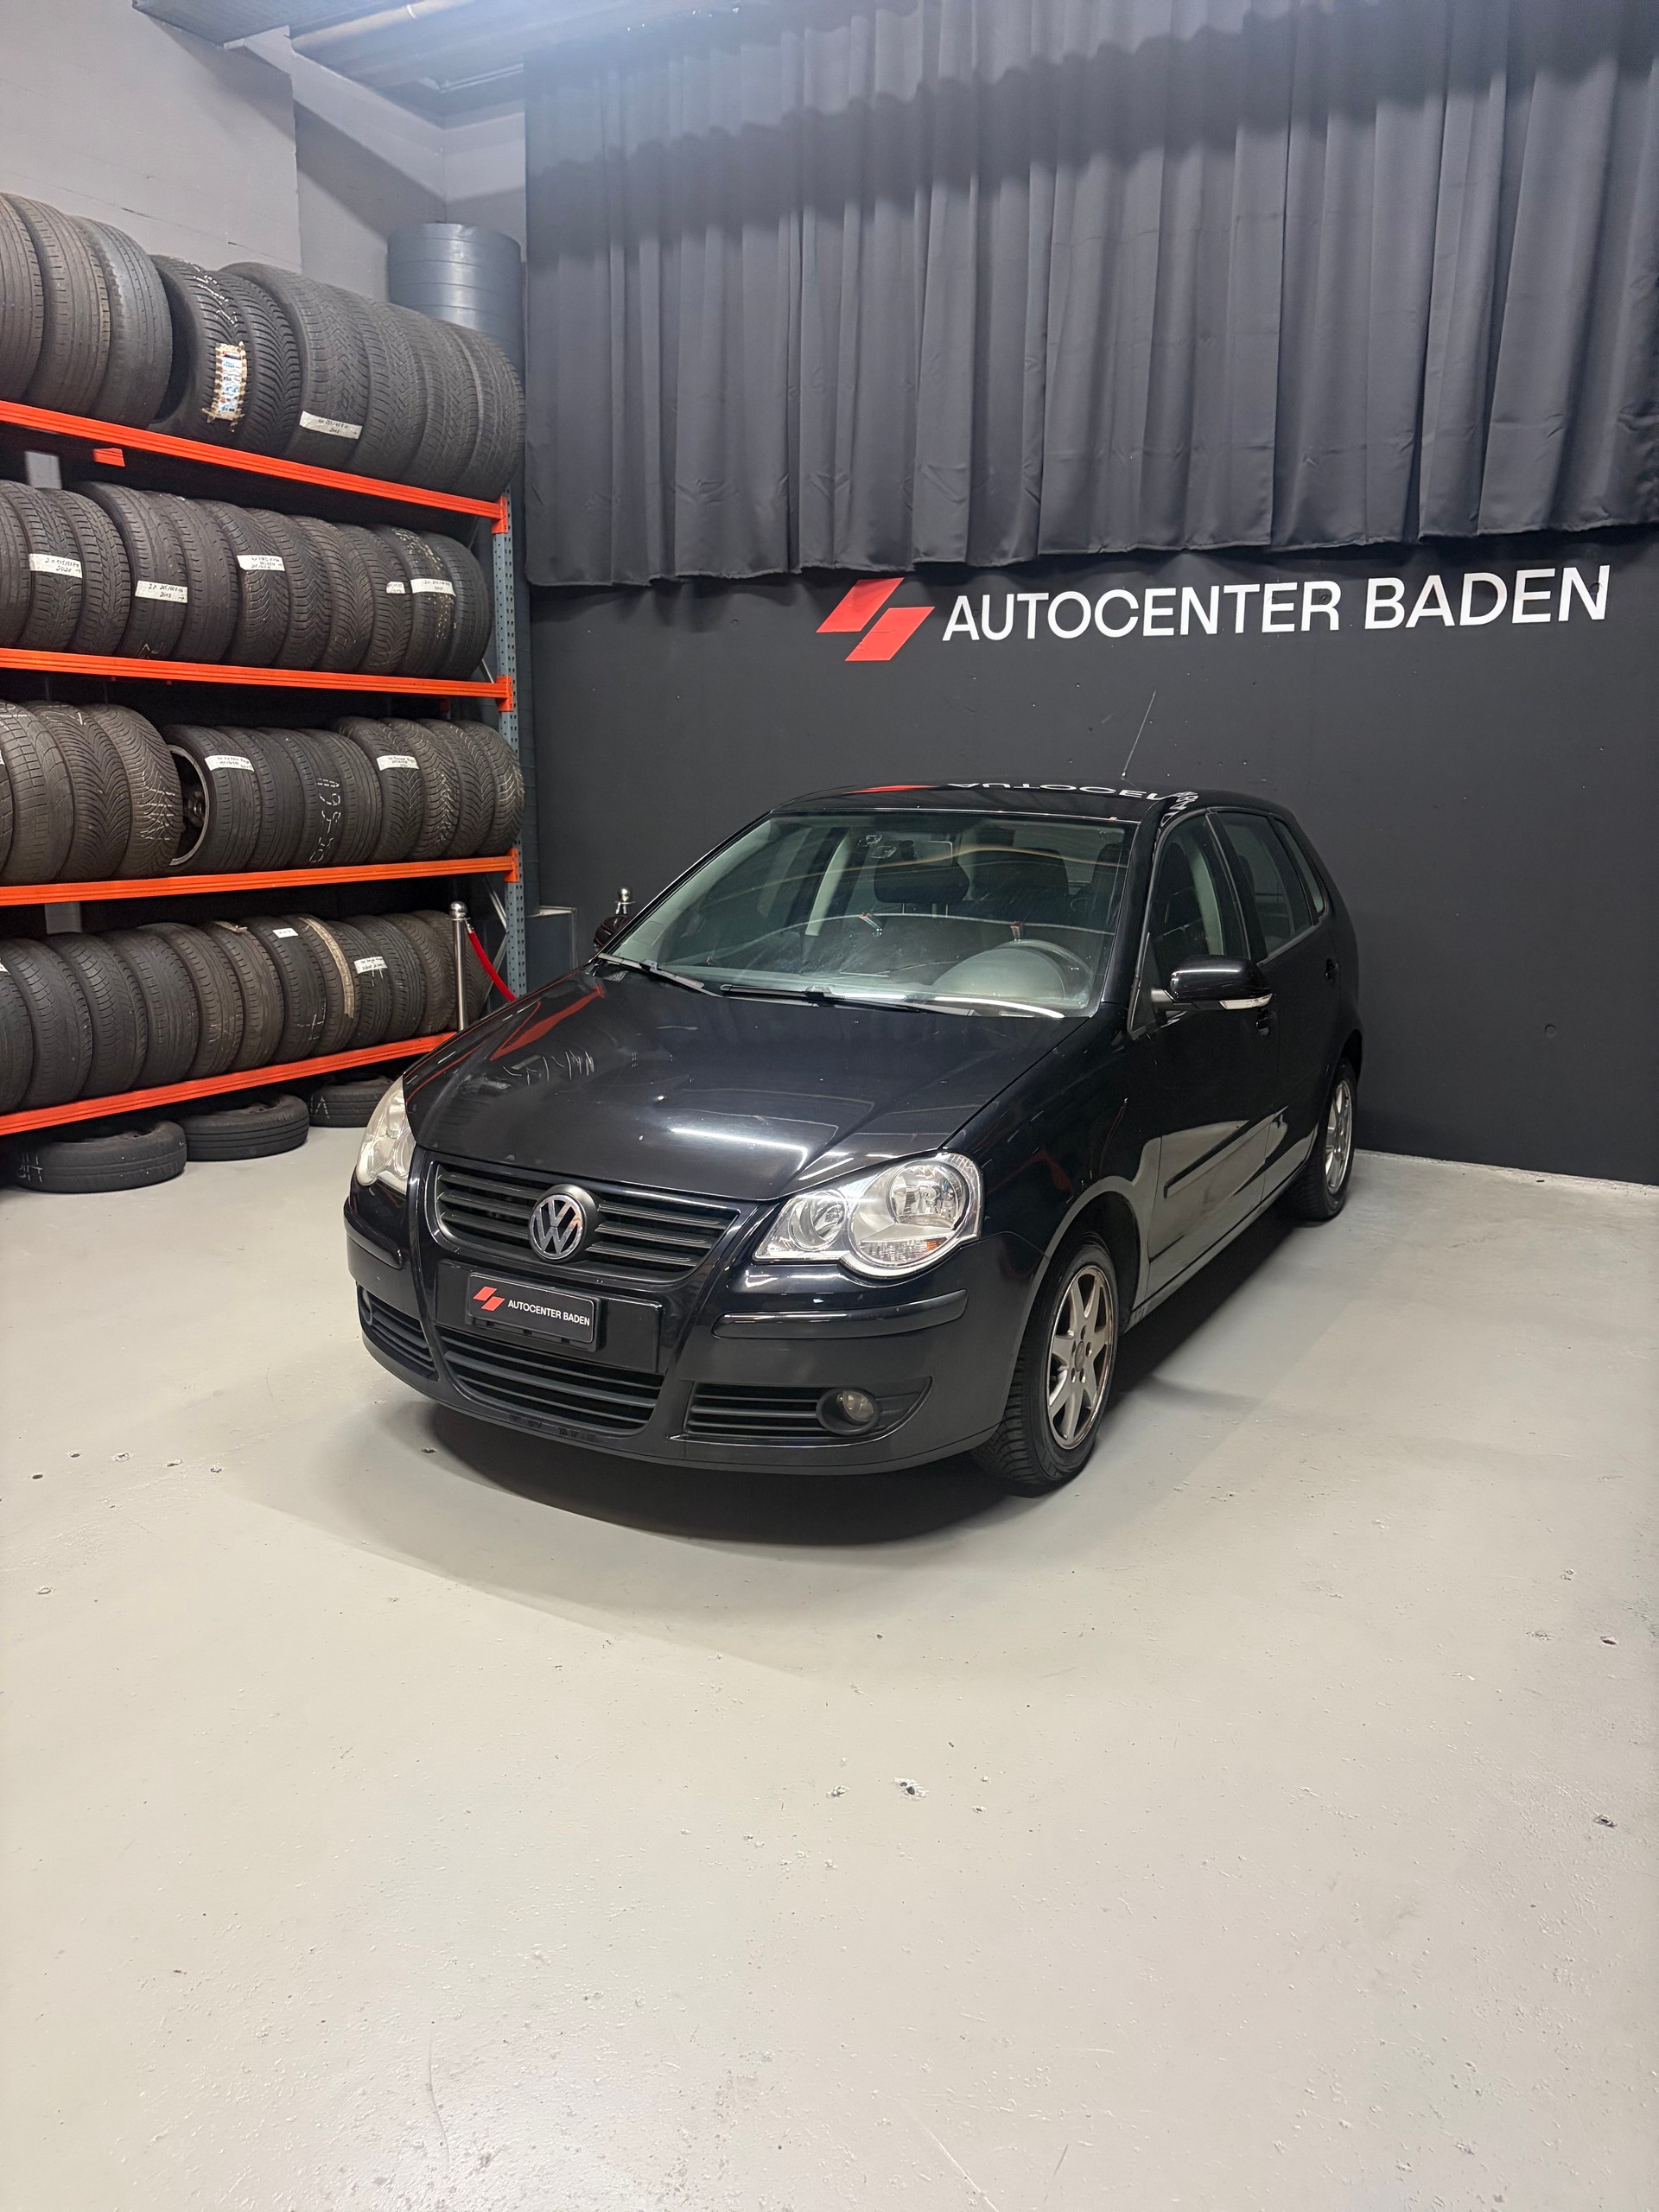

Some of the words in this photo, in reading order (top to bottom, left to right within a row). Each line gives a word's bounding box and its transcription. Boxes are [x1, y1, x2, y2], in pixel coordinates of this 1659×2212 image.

[942, 581, 1341, 641] AUTOCENTER
[1364, 564, 1611, 629] BADEN
[531, 1195, 583, 1259] VW
[507, 1300, 562, 1319] AUTOCENTER
[563, 1312, 590, 1326] BADEN
